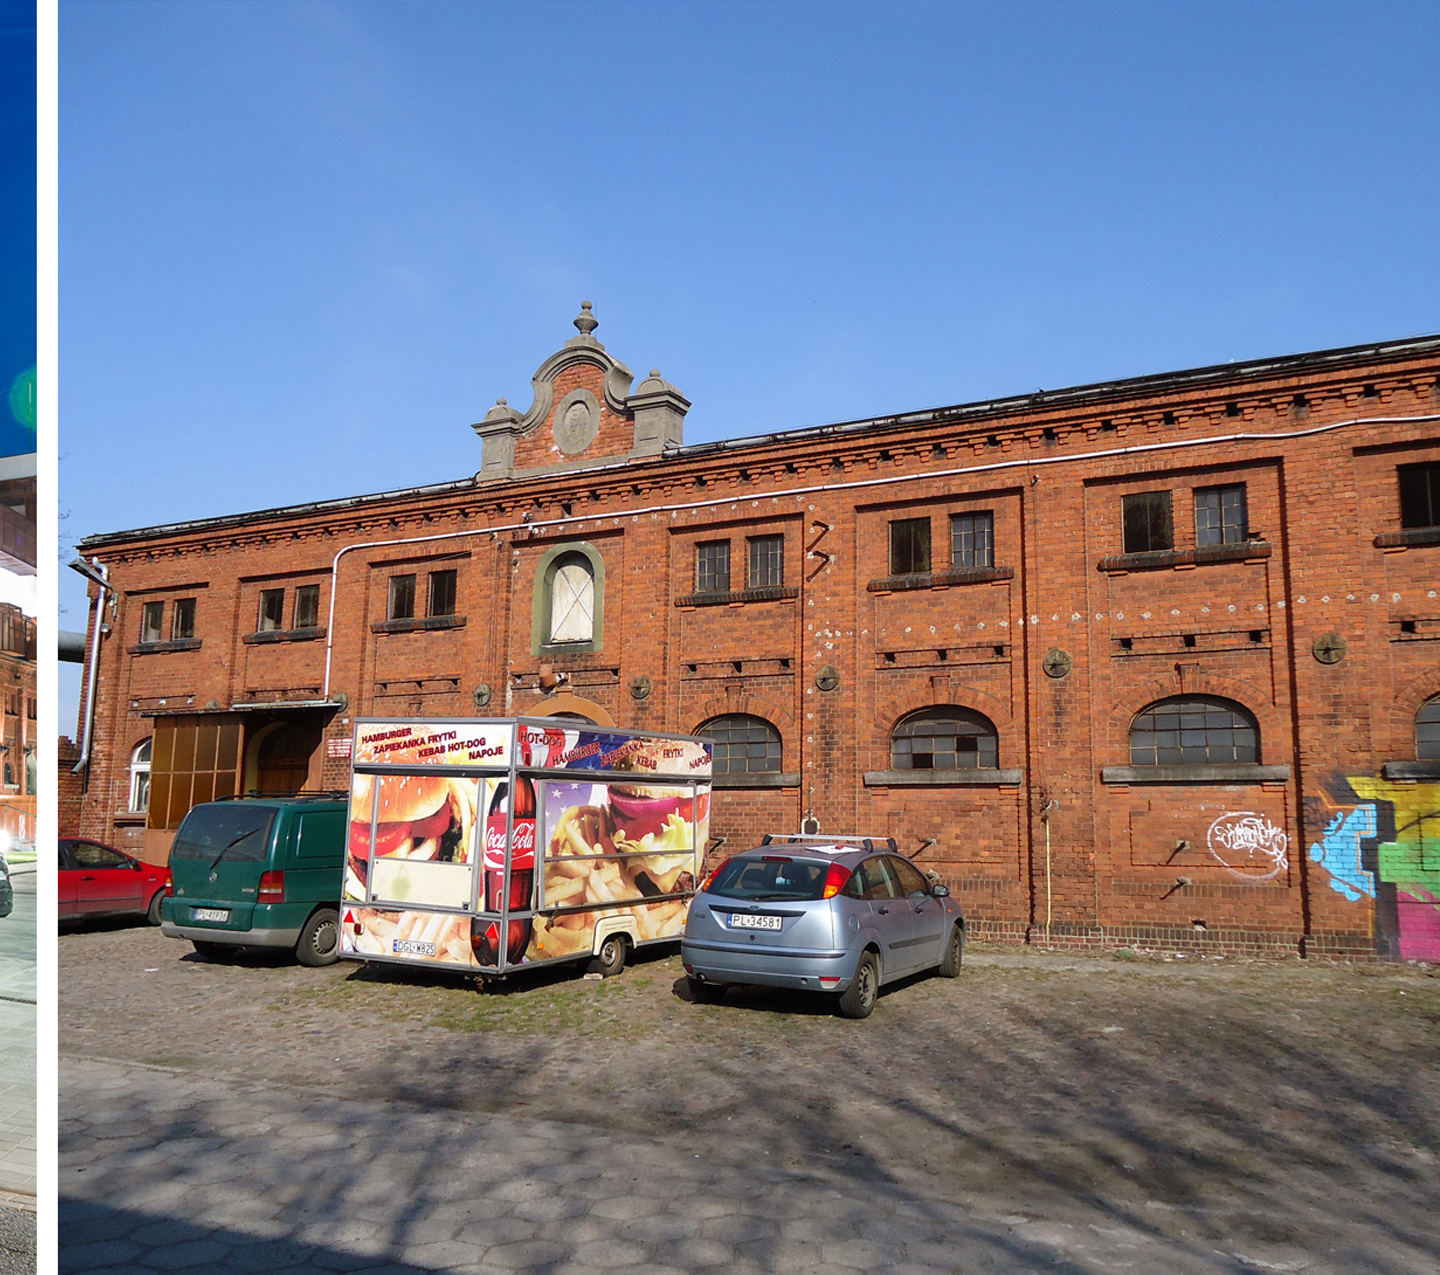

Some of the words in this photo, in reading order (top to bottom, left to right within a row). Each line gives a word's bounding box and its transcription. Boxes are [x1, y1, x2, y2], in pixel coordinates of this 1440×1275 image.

[361, 727, 413, 745] HAMBURGER
[373, 737, 427, 755] ZAPIEKANKA
[427, 730, 457, 745] FRYTKI
[520, 731, 564, 748] HOT-DOG
[417, 744, 446, 759] KEBAB
[447, 737, 487, 752] HOT-DOG
[468, 745, 504, 761] NAPOJE
[552, 740, 602, 766] HAMBURGER
[600, 740, 645, 767] ZAPIEKANKA
[662, 747, 684, 759] FRYTKI
[635, 754, 658, 771] KEBAB
